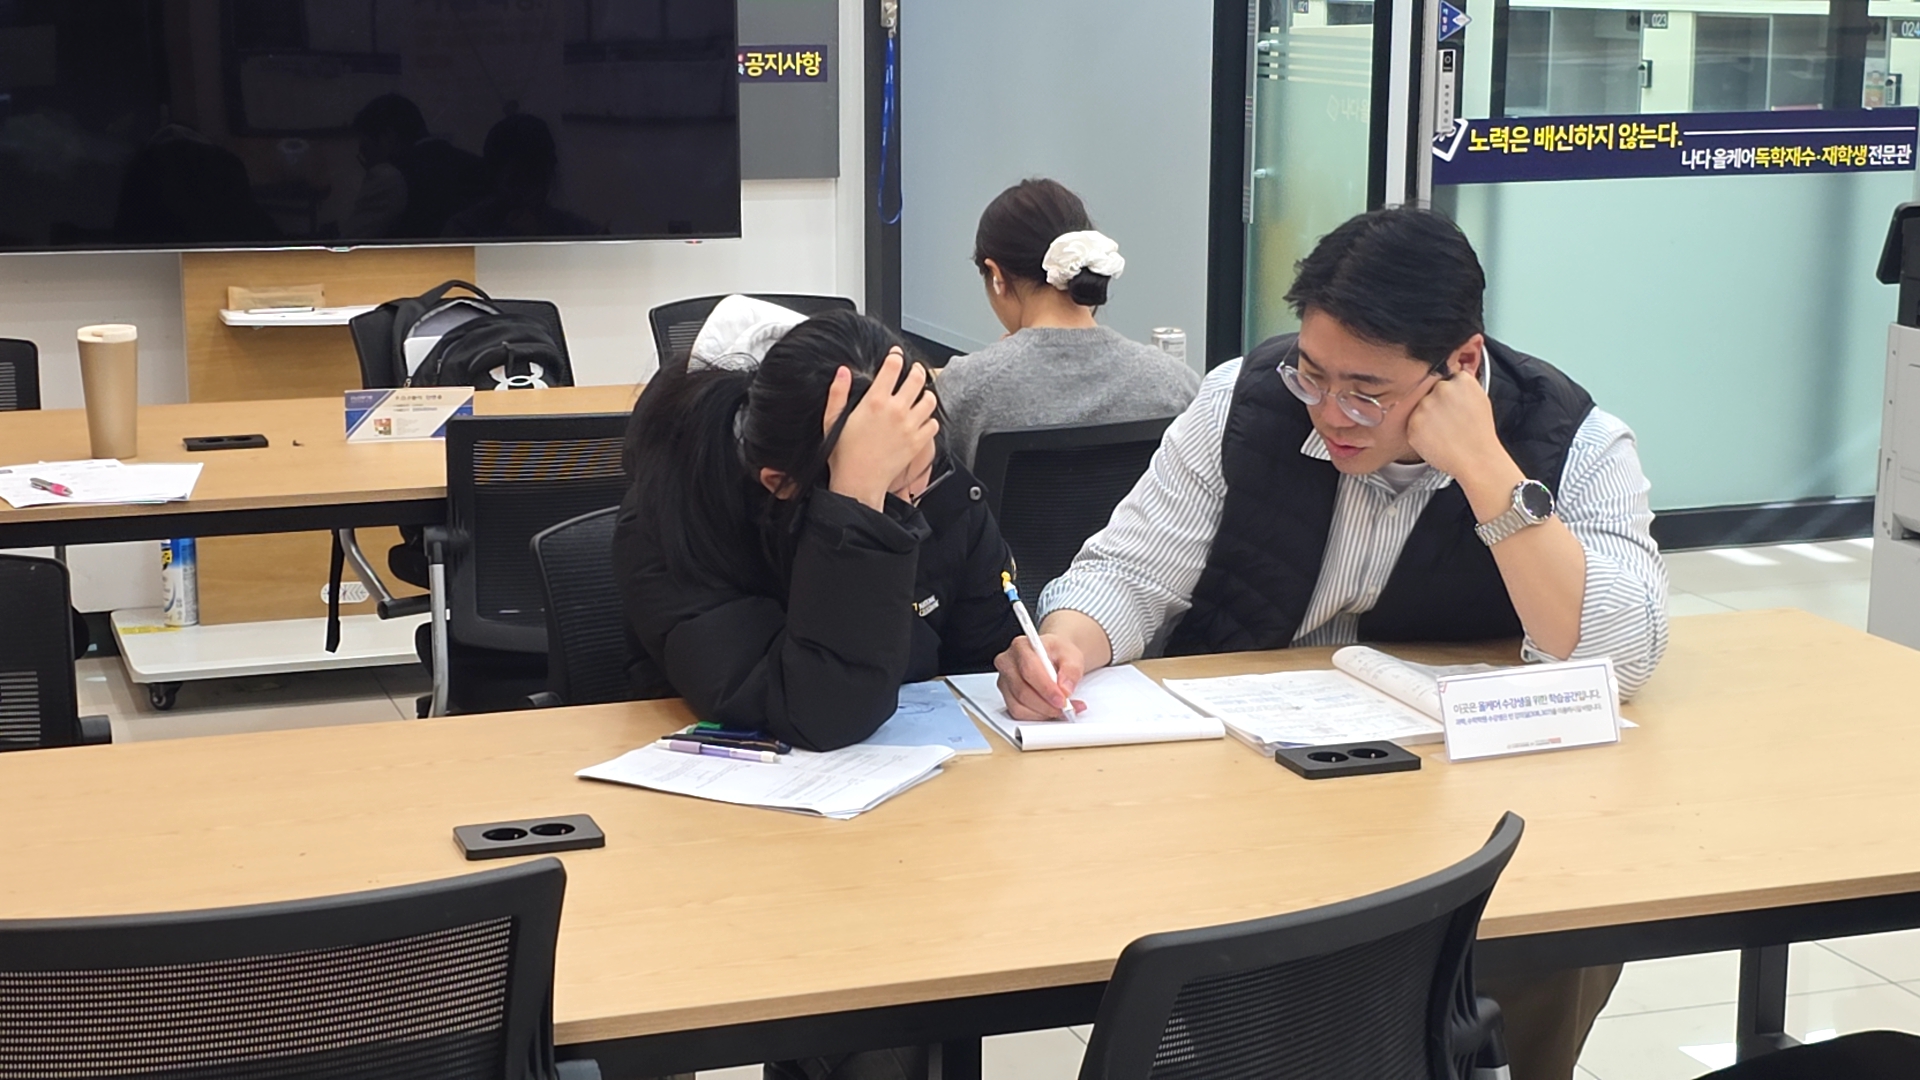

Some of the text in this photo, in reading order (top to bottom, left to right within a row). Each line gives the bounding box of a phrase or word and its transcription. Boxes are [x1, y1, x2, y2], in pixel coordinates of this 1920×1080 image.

[1651, 13, 1667, 28] 023
[1901, 20, 1920, 37] 024
[744, 50, 823, 77] 공지사항
[1467, 121, 1684, 154] 노력은 배신하지 않는다.
[1453, 702, 1477, 715] 이곳은
[1478, 699, 1501, 712] 올케어
[1502, 696, 1532, 710] 수강생을
[1533, 693, 1549, 707] 위한
